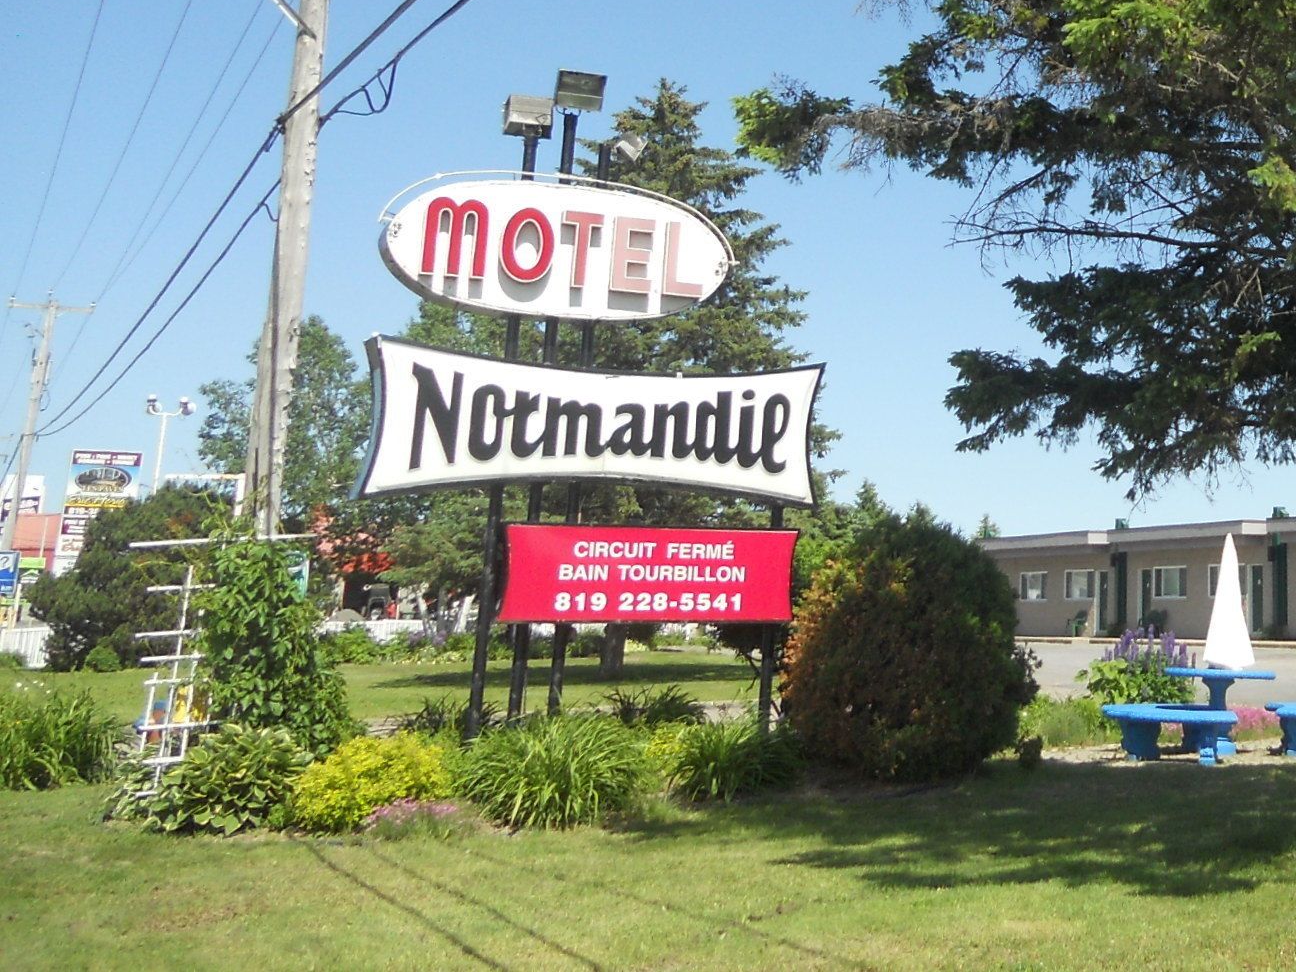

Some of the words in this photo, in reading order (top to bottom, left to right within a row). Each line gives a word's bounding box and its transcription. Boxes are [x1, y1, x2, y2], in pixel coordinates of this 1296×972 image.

[419, 196, 703, 298] MOTEL
[408, 362, 791, 474] Normandie
[573, 541, 657, 559] CIRCUIT
[666, 540, 735, 560] FERMÉ
[558, 564, 609, 581] BAIN
[617, 564, 746, 582] TOURBILLON
[554, 592, 607, 611] 819
[618, 592, 743, 611] 228-5541
